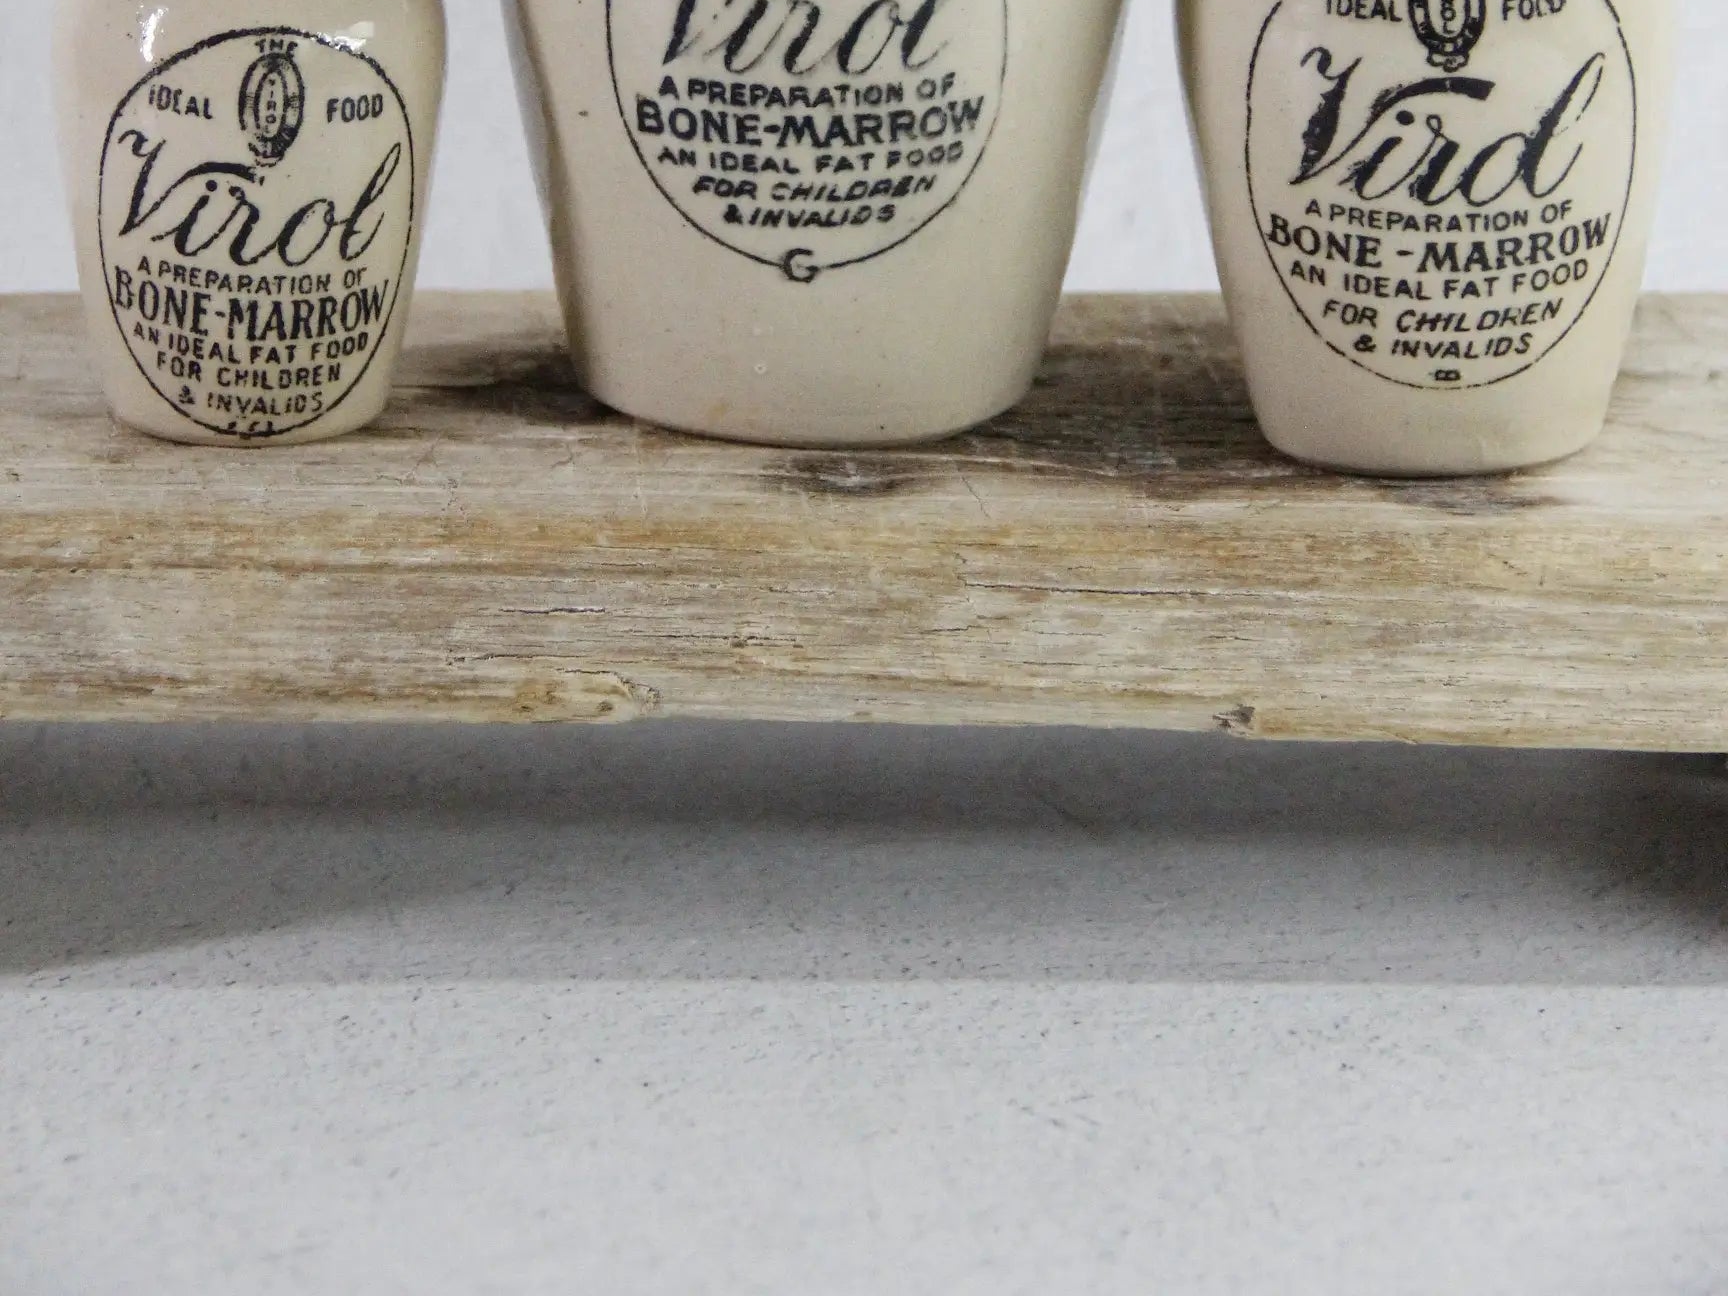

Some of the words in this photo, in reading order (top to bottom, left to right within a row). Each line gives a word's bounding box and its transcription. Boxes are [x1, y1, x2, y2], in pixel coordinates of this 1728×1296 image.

[255, 39, 298, 56] THE
[148, 84, 213, 120] IDEAL
[327, 94, 384, 122] FOOD
[658, 76, 680, 99] A
[687, 78, 904, 108] PREPARATION
[917, 72, 956, 99] OF
[635, 93, 984, 148] BONE-MARROW
[1289, 46, 1606, 207] Virol
[658, 146, 696, 166] AN
[710, 151, 800, 174] IDEAL
[815, 152, 874, 173] FAT
[118, 129, 401, 267] Virol
[693, 176, 757, 199] FOR
[1305, 199, 1323, 216] A
[1329, 208, 1528, 233] PREPARATION
[1541, 200, 1572, 221] OF
[137, 256, 151, 274] A
[158, 262, 331, 295] PREPARATION
[1290, 262, 1325, 286] AN
[1344, 275, 1430, 300] IDEAL
[1443, 276, 1500, 299] FAT
[1512, 258, 1588, 291] FOOD
[115, 265, 388, 341] BONE-MARROW
[1323, 300, 1377, 328] FOR
[1396, 298, 1563, 333] CHILDREN
[133, 322, 160, 345] AN
[169, 334, 237, 364] IDEAL
[250, 343, 295, 364] FAT
[310, 332, 368, 360] FOOD
[1392, 333, 1534, 359] INVALIDS
[157, 352, 202, 380] FOR
[217, 362, 340, 389] CHILDREN
[207, 391, 323, 416] INVALIDS
